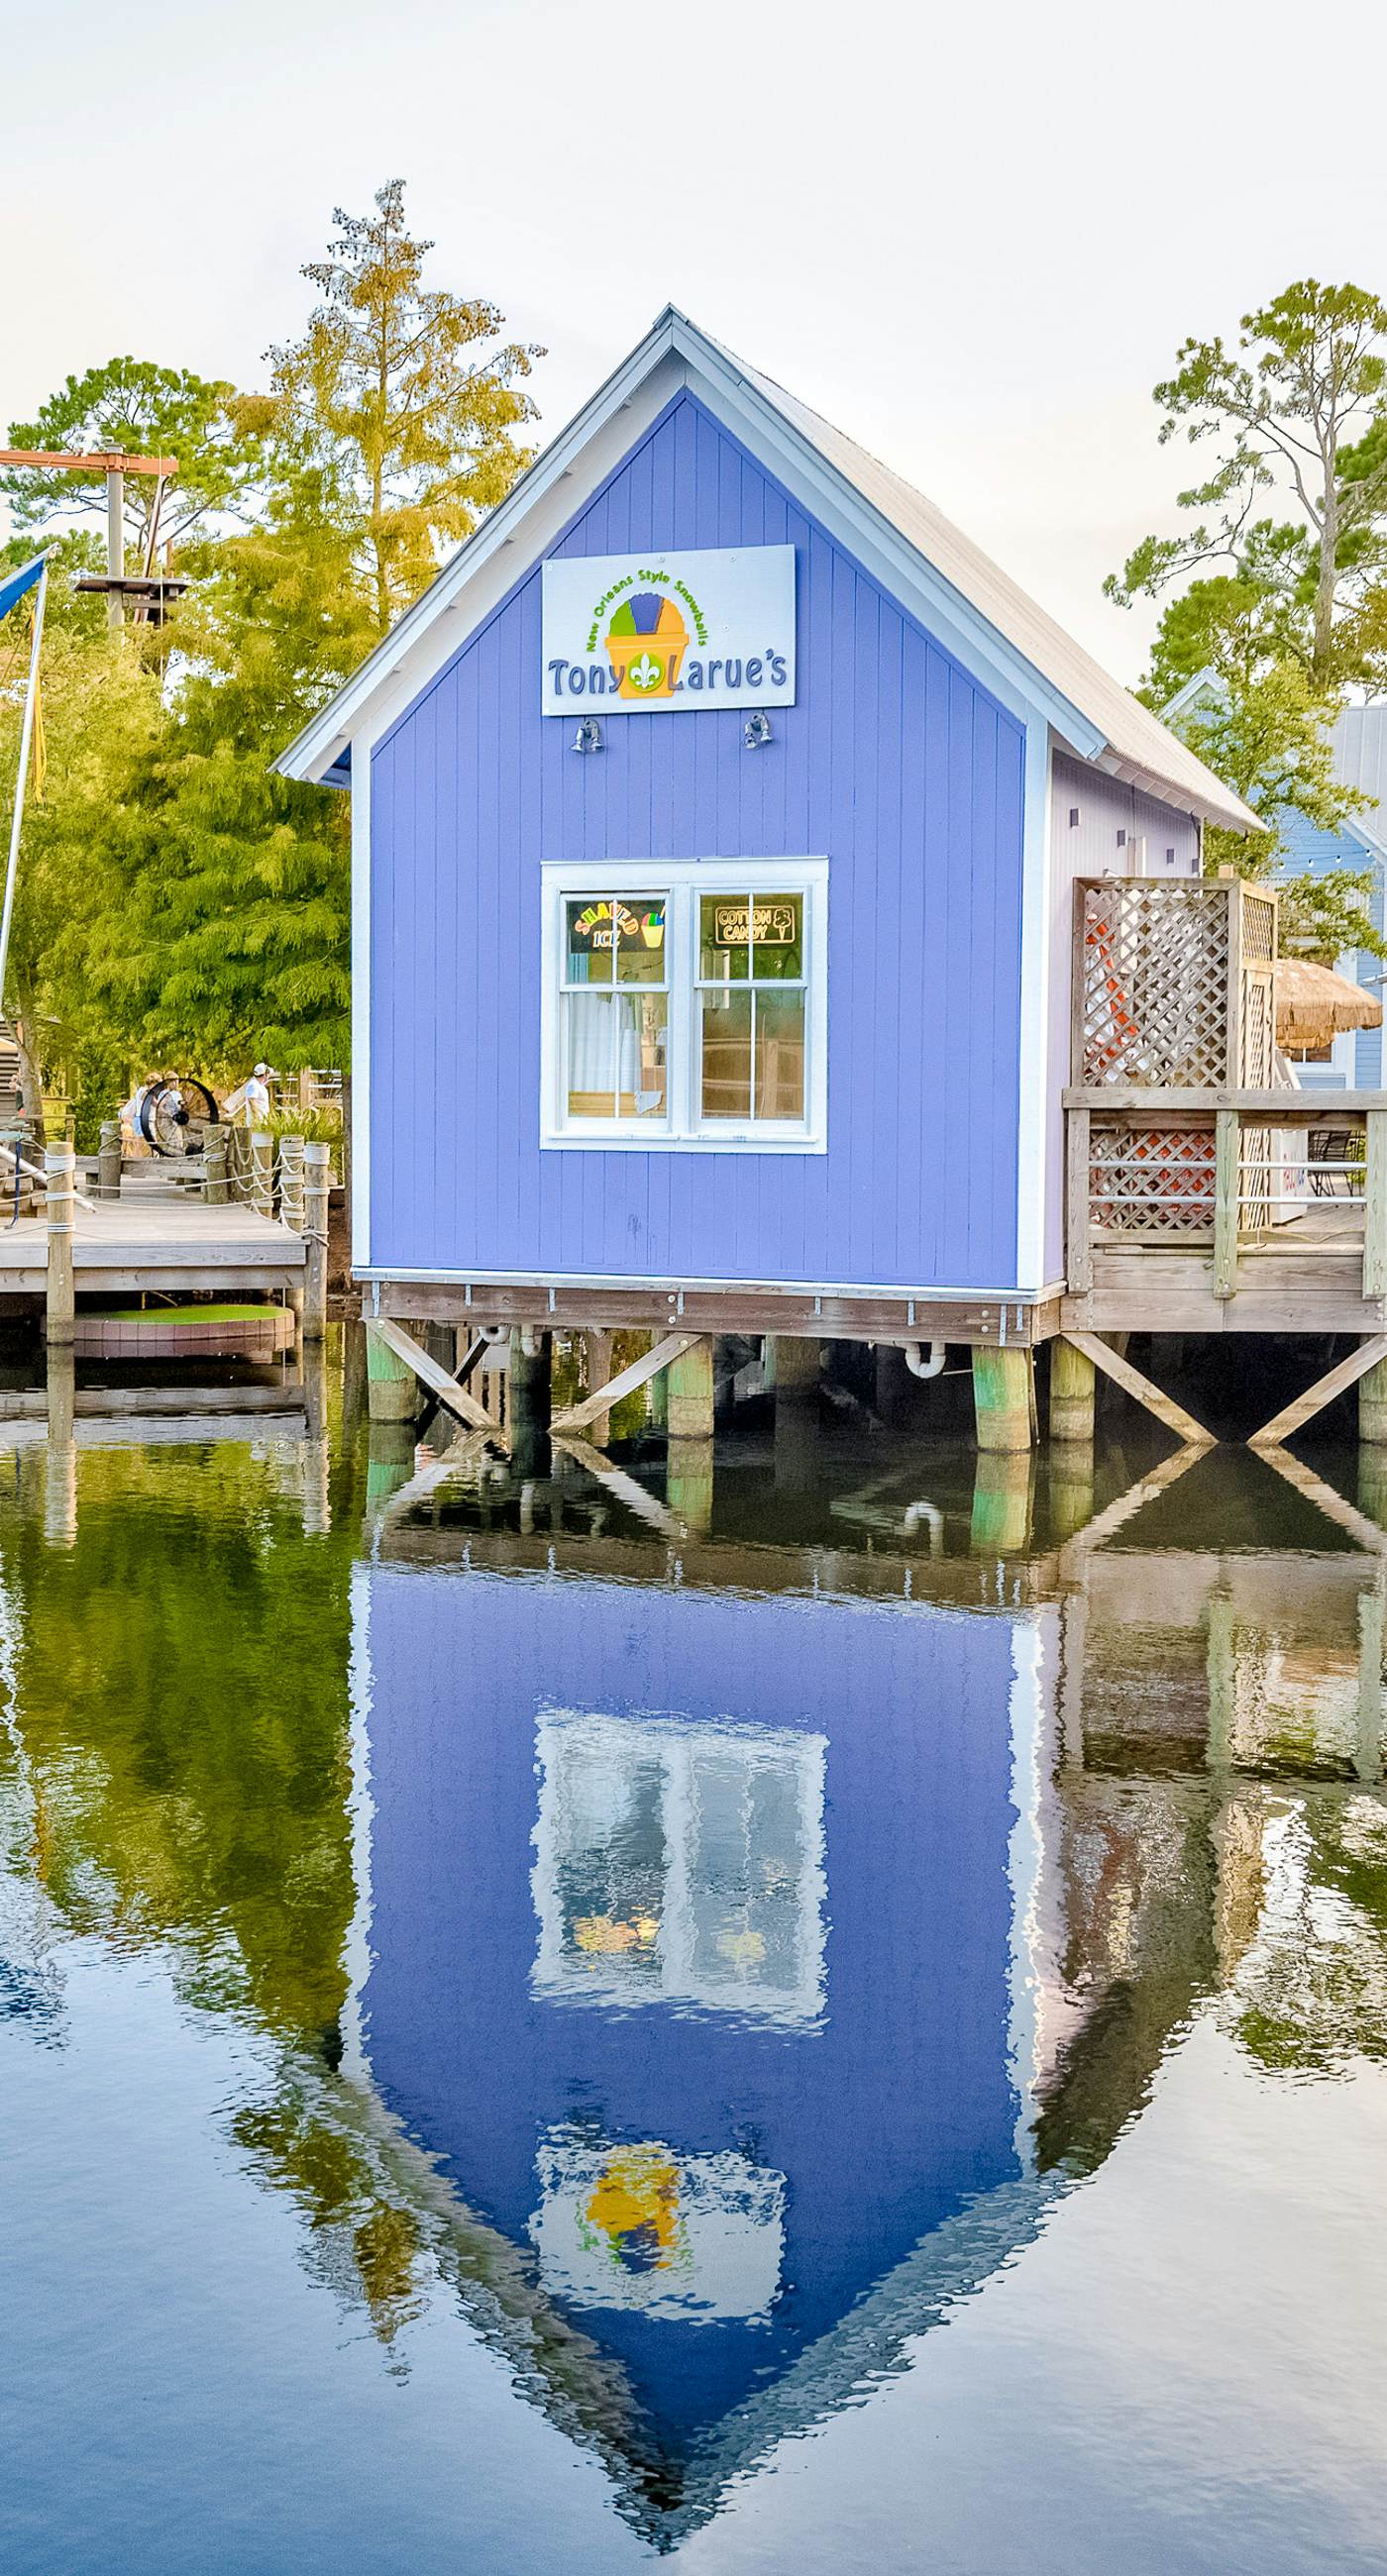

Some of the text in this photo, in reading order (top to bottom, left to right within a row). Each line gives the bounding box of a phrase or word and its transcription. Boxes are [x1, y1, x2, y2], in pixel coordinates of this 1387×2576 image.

[587, 569, 708, 652] New Orleans Style Snowballs
[548, 648, 788, 695] Tony Larue's
[575, 902, 639, 936] SHAVED
[718, 909, 772, 925] COTTON
[592, 930, 622, 948] ICE
[723, 924, 768, 941] CANDY
